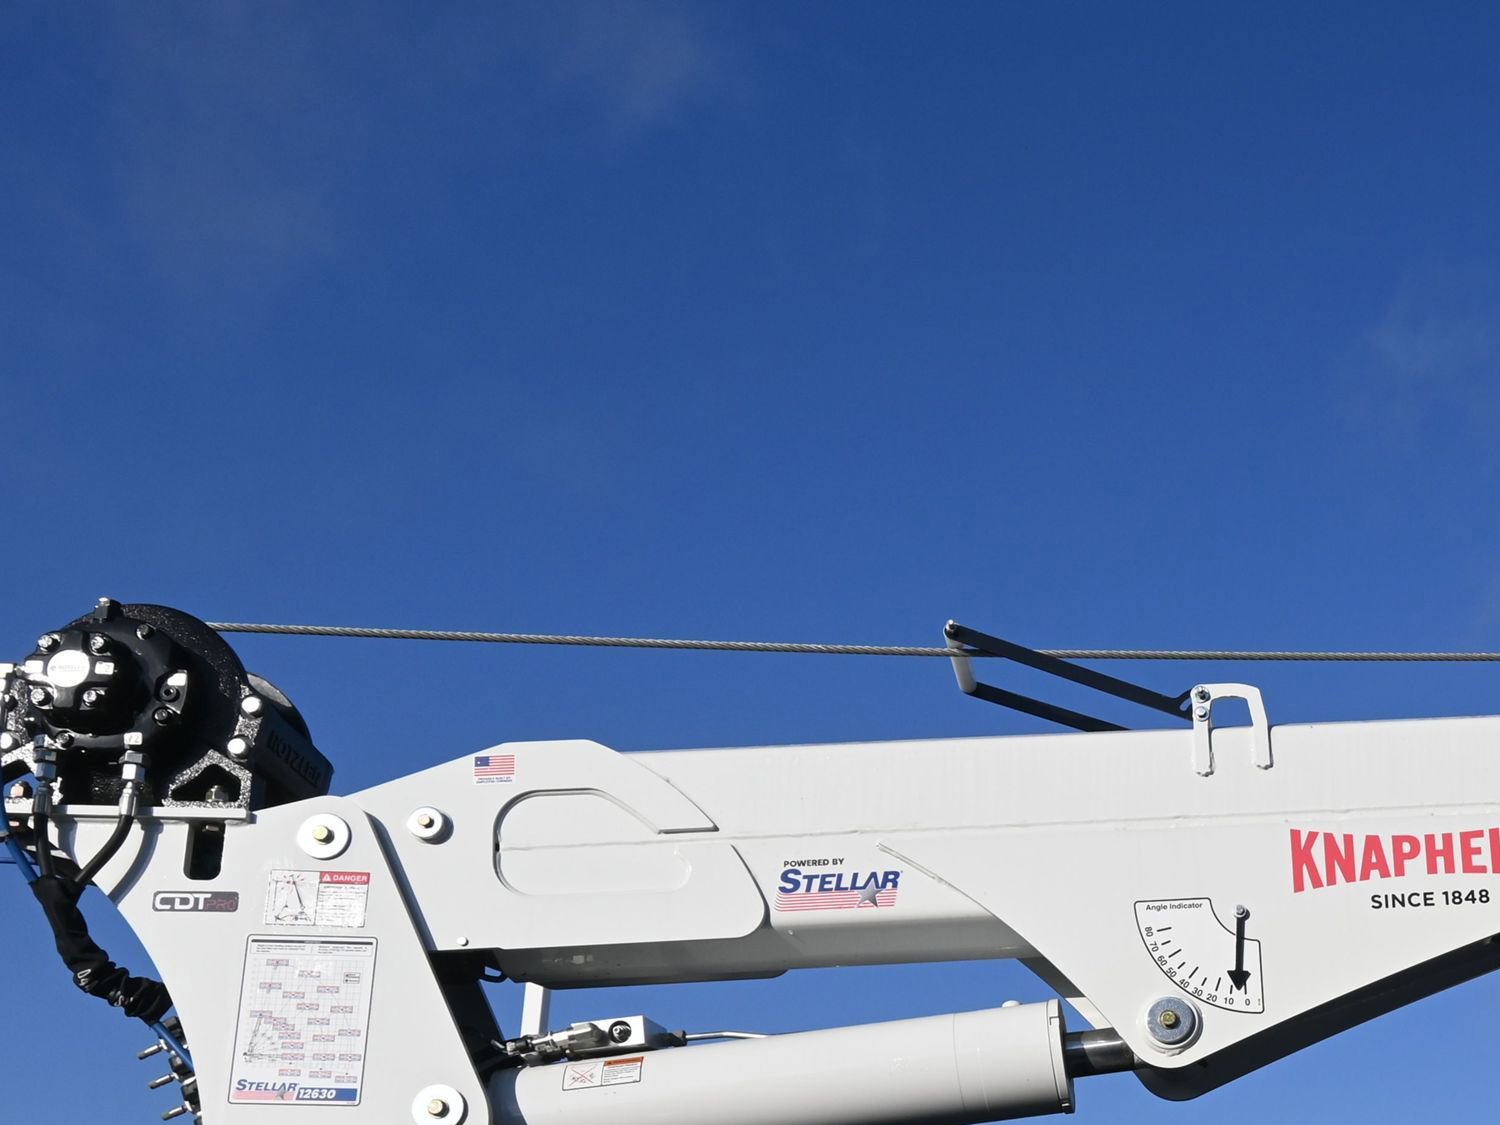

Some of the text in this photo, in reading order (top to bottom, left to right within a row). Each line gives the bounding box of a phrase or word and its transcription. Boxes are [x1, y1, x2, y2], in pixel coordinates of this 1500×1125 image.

[783, 858, 845, 867] POWERED BY
[778, 868, 901, 893] STELLAR
[155, 893, 212, 911] CDT
[1371, 889, 1490, 909] SINCE 1848
[1145, 902, 1204, 912] Angle Indicator
[1144, 926, 1154, 937] 80
[1149, 941, 1159, 952] 70
[1157, 955, 1168, 966] 60
[1166, 967, 1177, 978] 50
[1179, 978, 1190, 989] 40
[1191, 987, 1204, 997] 30
[1206, 993, 1218, 1003] 20
[1224, 997, 1235, 1005] 10
[1244, 998, 1251, 1006] 0
[236, 1079, 298, 1092] STELLAR
[299, 1089, 336, 1099] 12630
